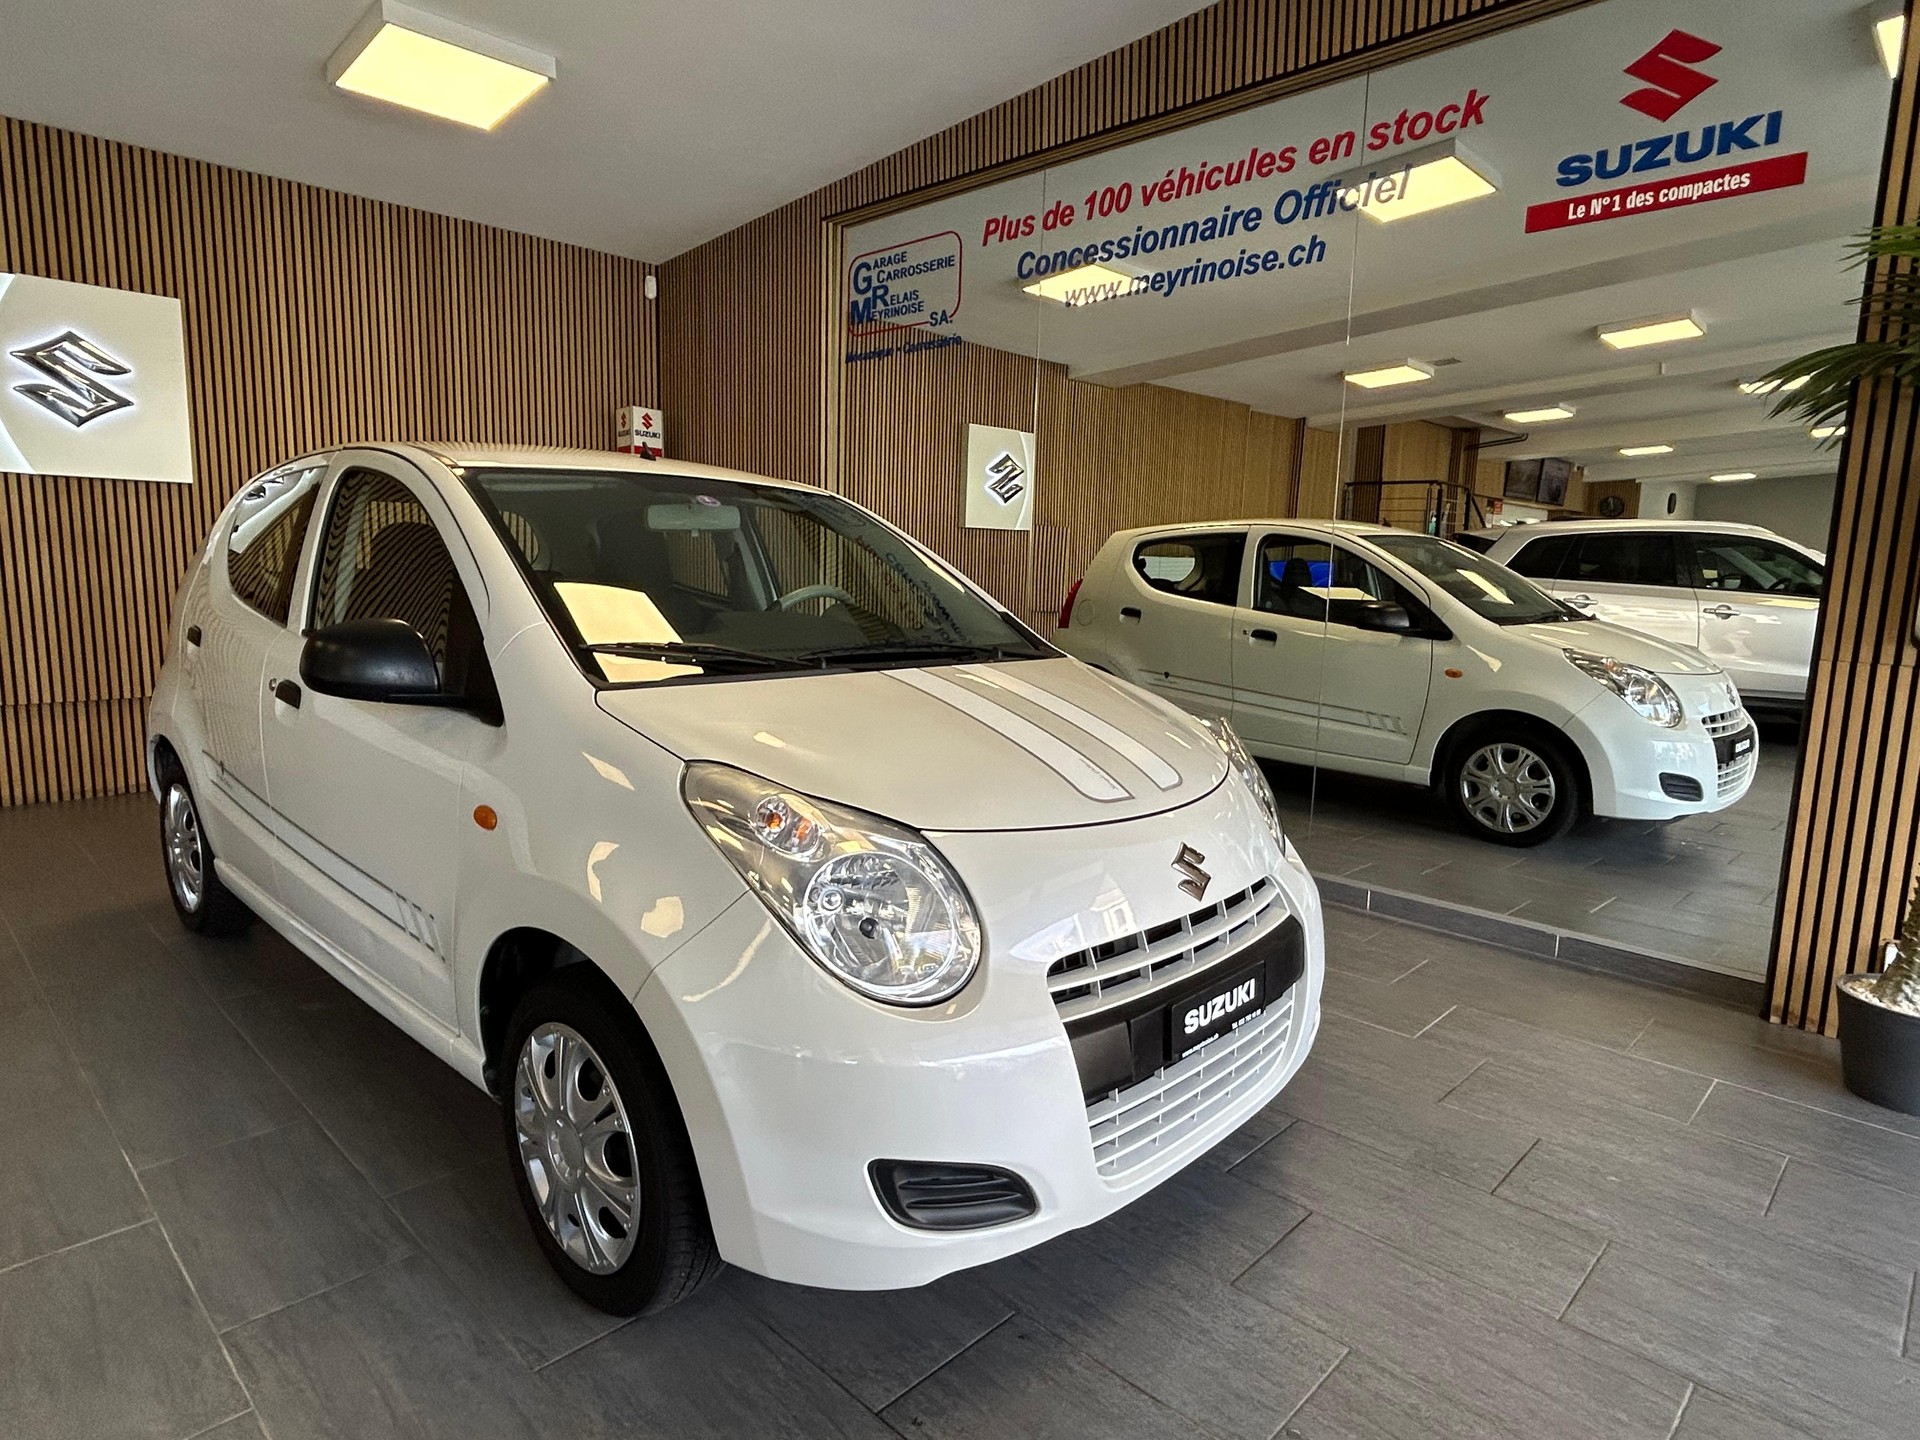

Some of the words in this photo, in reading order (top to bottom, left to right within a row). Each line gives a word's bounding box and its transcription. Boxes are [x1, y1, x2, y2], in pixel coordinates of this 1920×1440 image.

[982, 213, 1036, 247] Plus
[1042, 200, 1075, 231] de
[1084, 182, 1133, 220] 100
[1141, 147, 1297, 206] véhicules
[1308, 130, 1356, 165] en
[1367, 88, 1490, 152] stock
[1555, 110, 1783, 187] SUZUKI
[1017, 205, 1263, 280] Concessionnaire
[1273, 163, 1414, 225] Officiel
[1567, 202, 1586, 220] Le
[1626, 190, 1655, 210] des
[1658, 172, 1751, 201] compactes
[876, 254, 956, 284] CARROSSERIE
[1064, 234, 1327, 308] www.meyrinoise.ch
[850, 297, 925, 326] MEYRINOISE
[871, 283, 920, 310] RELAIS
[635, 429, 660, 438] SUZUKI
[1184, 977, 1256, 1035] SUZUKI
